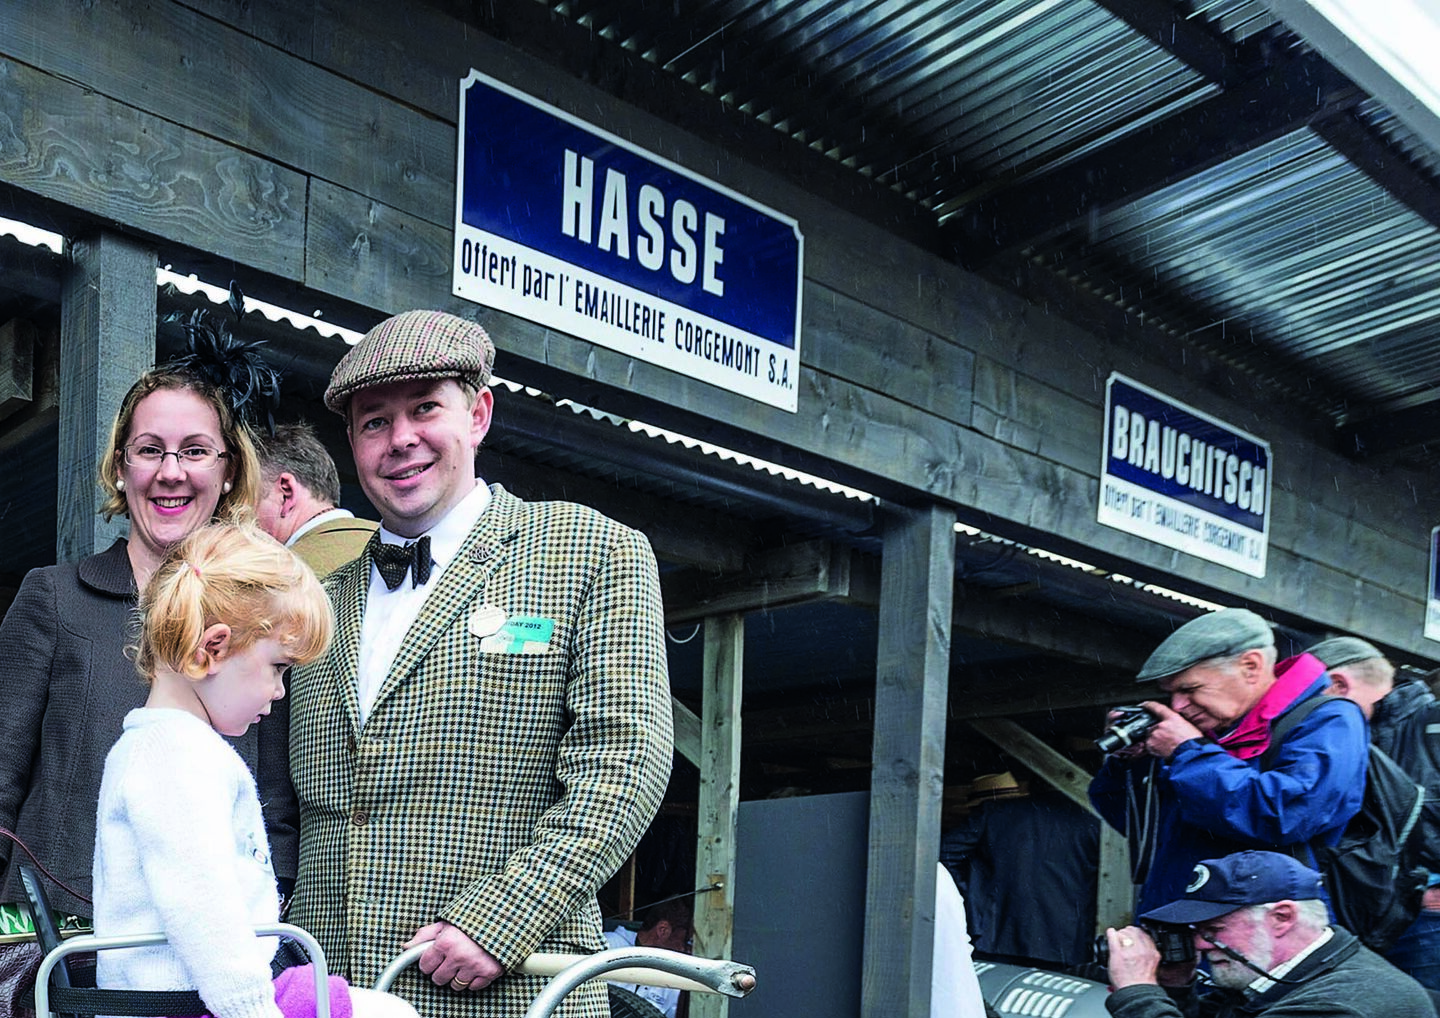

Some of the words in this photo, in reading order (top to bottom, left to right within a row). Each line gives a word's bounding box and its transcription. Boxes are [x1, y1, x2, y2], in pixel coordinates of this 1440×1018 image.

[560, 148, 727, 299] HASSE
[461, 238, 517, 290] Offert
[522, 263, 555, 302] par
[574, 280, 666, 344] EMAILLERIE
[674, 317, 761, 378] CORGEMONT
[767, 353, 794, 391] S.A.
[1112, 404, 1265, 515] BRAUCHITSCH
